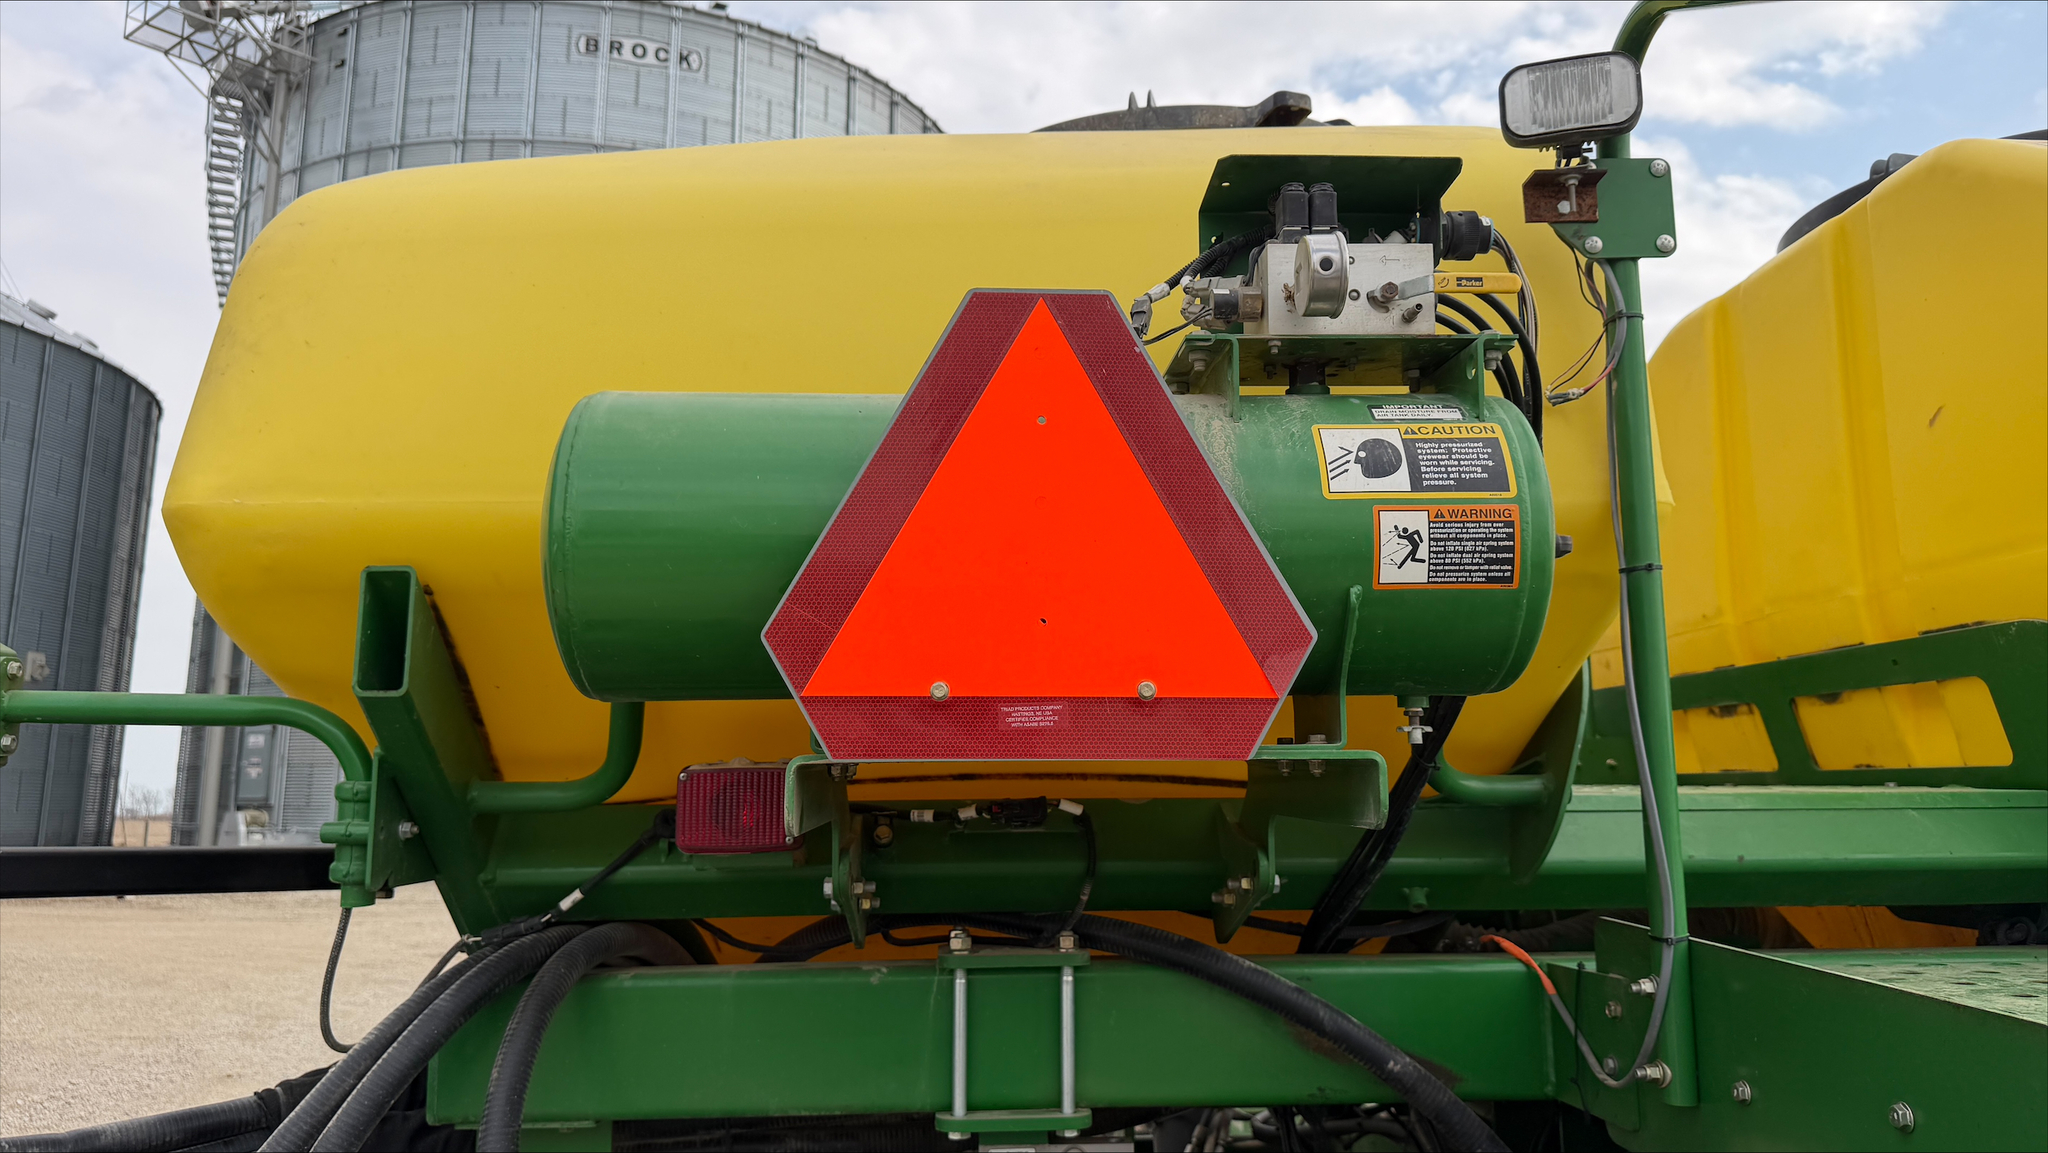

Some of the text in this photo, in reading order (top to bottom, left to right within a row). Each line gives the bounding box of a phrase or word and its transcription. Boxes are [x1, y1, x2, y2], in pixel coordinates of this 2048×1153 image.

[585, 37, 692, 71] BROCK
[1418, 426, 1496, 435] CAUTION
[1447, 508, 1512, 519] WARNING
